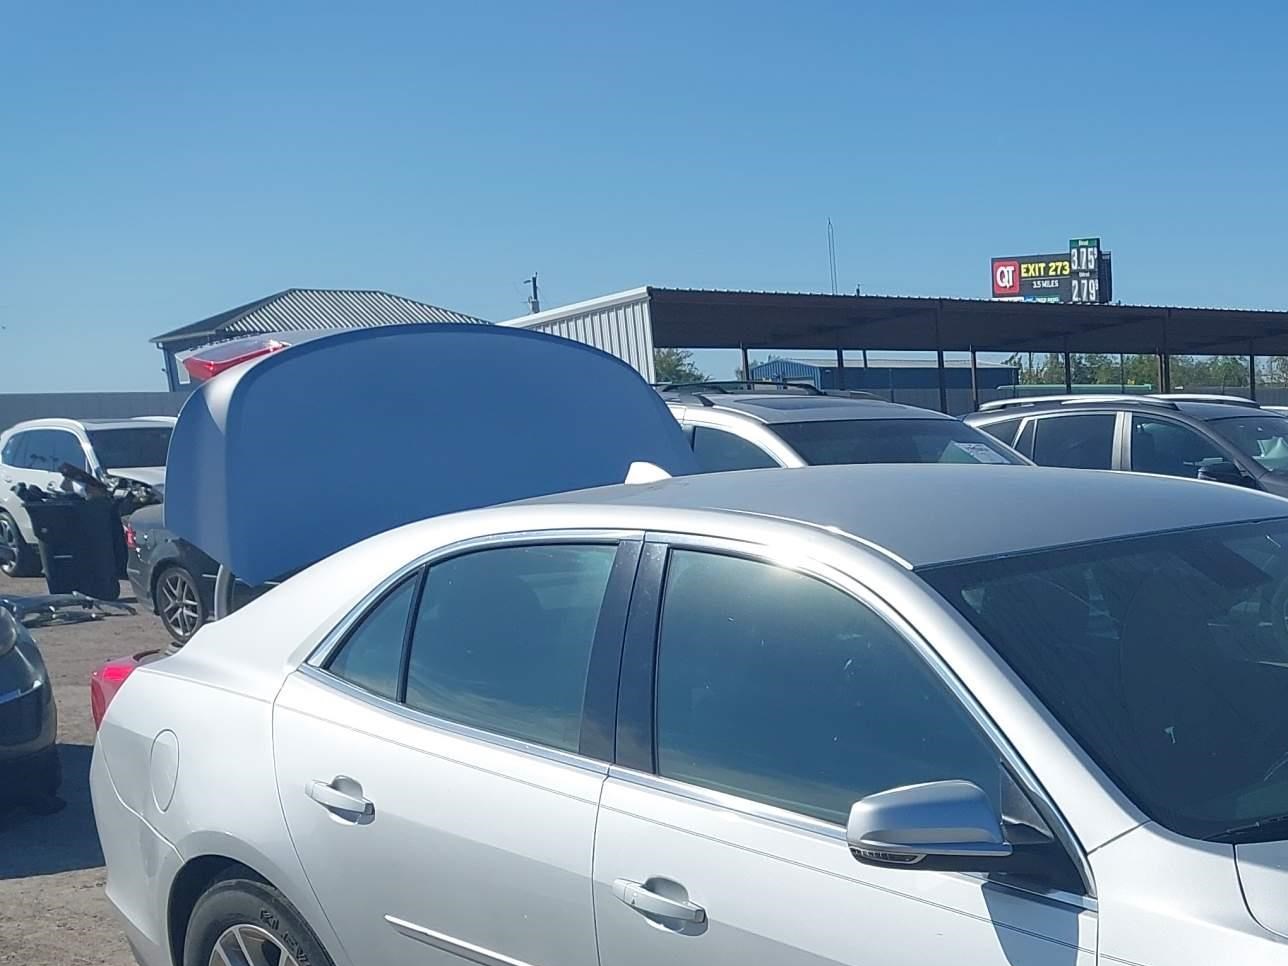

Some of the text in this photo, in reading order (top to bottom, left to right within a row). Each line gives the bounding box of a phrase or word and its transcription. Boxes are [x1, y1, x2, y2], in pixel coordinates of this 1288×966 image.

[996, 266, 1014, 288] QT
[1021, 262, 1046, 277] EXIT
[1048, 261, 1070, 276] 273
